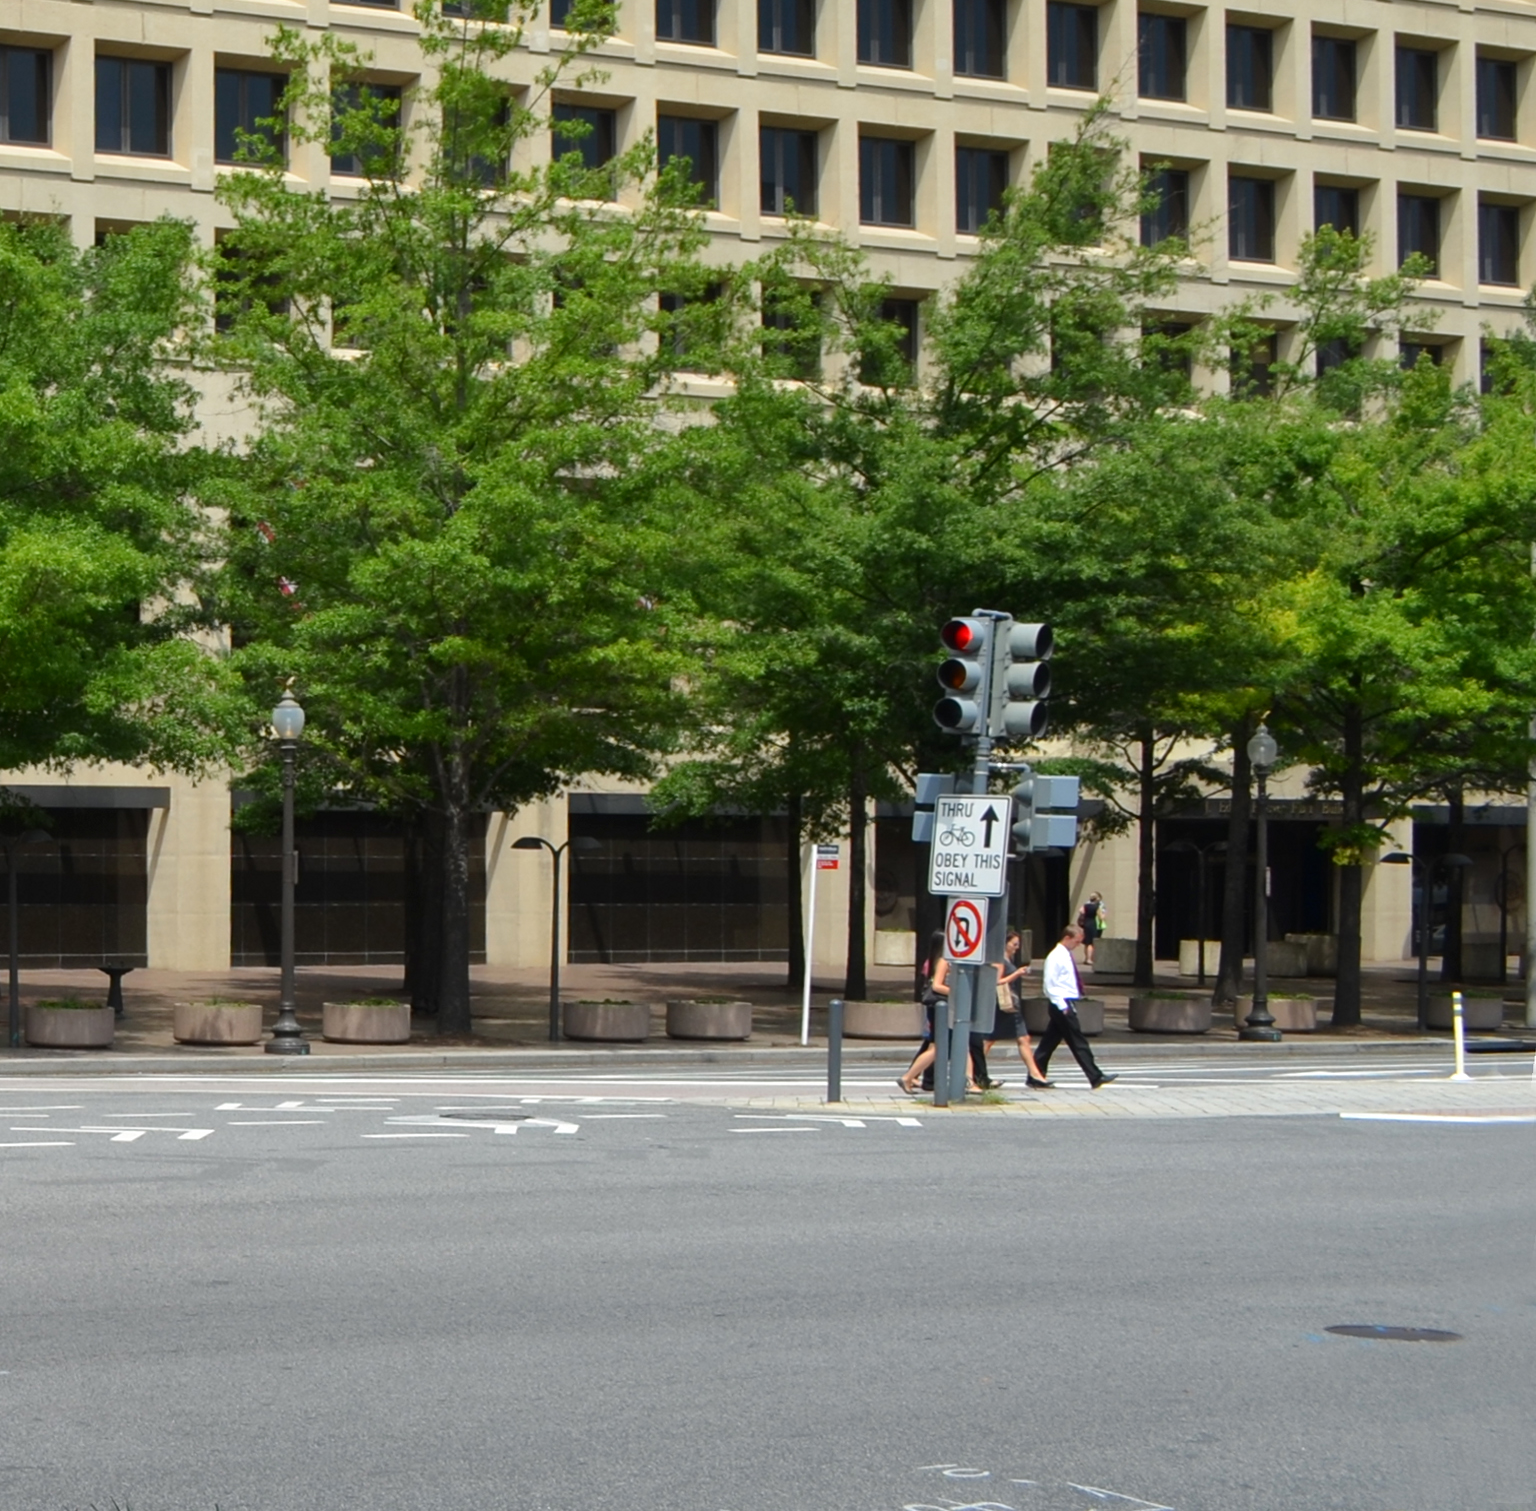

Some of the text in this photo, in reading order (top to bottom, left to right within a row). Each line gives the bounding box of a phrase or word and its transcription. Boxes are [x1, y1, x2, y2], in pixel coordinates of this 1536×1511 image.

[941, 802, 974, 818] THRU
[935, 852, 1001, 870] OBEY THIS
[934, 871, 977, 887] SIGNAL
